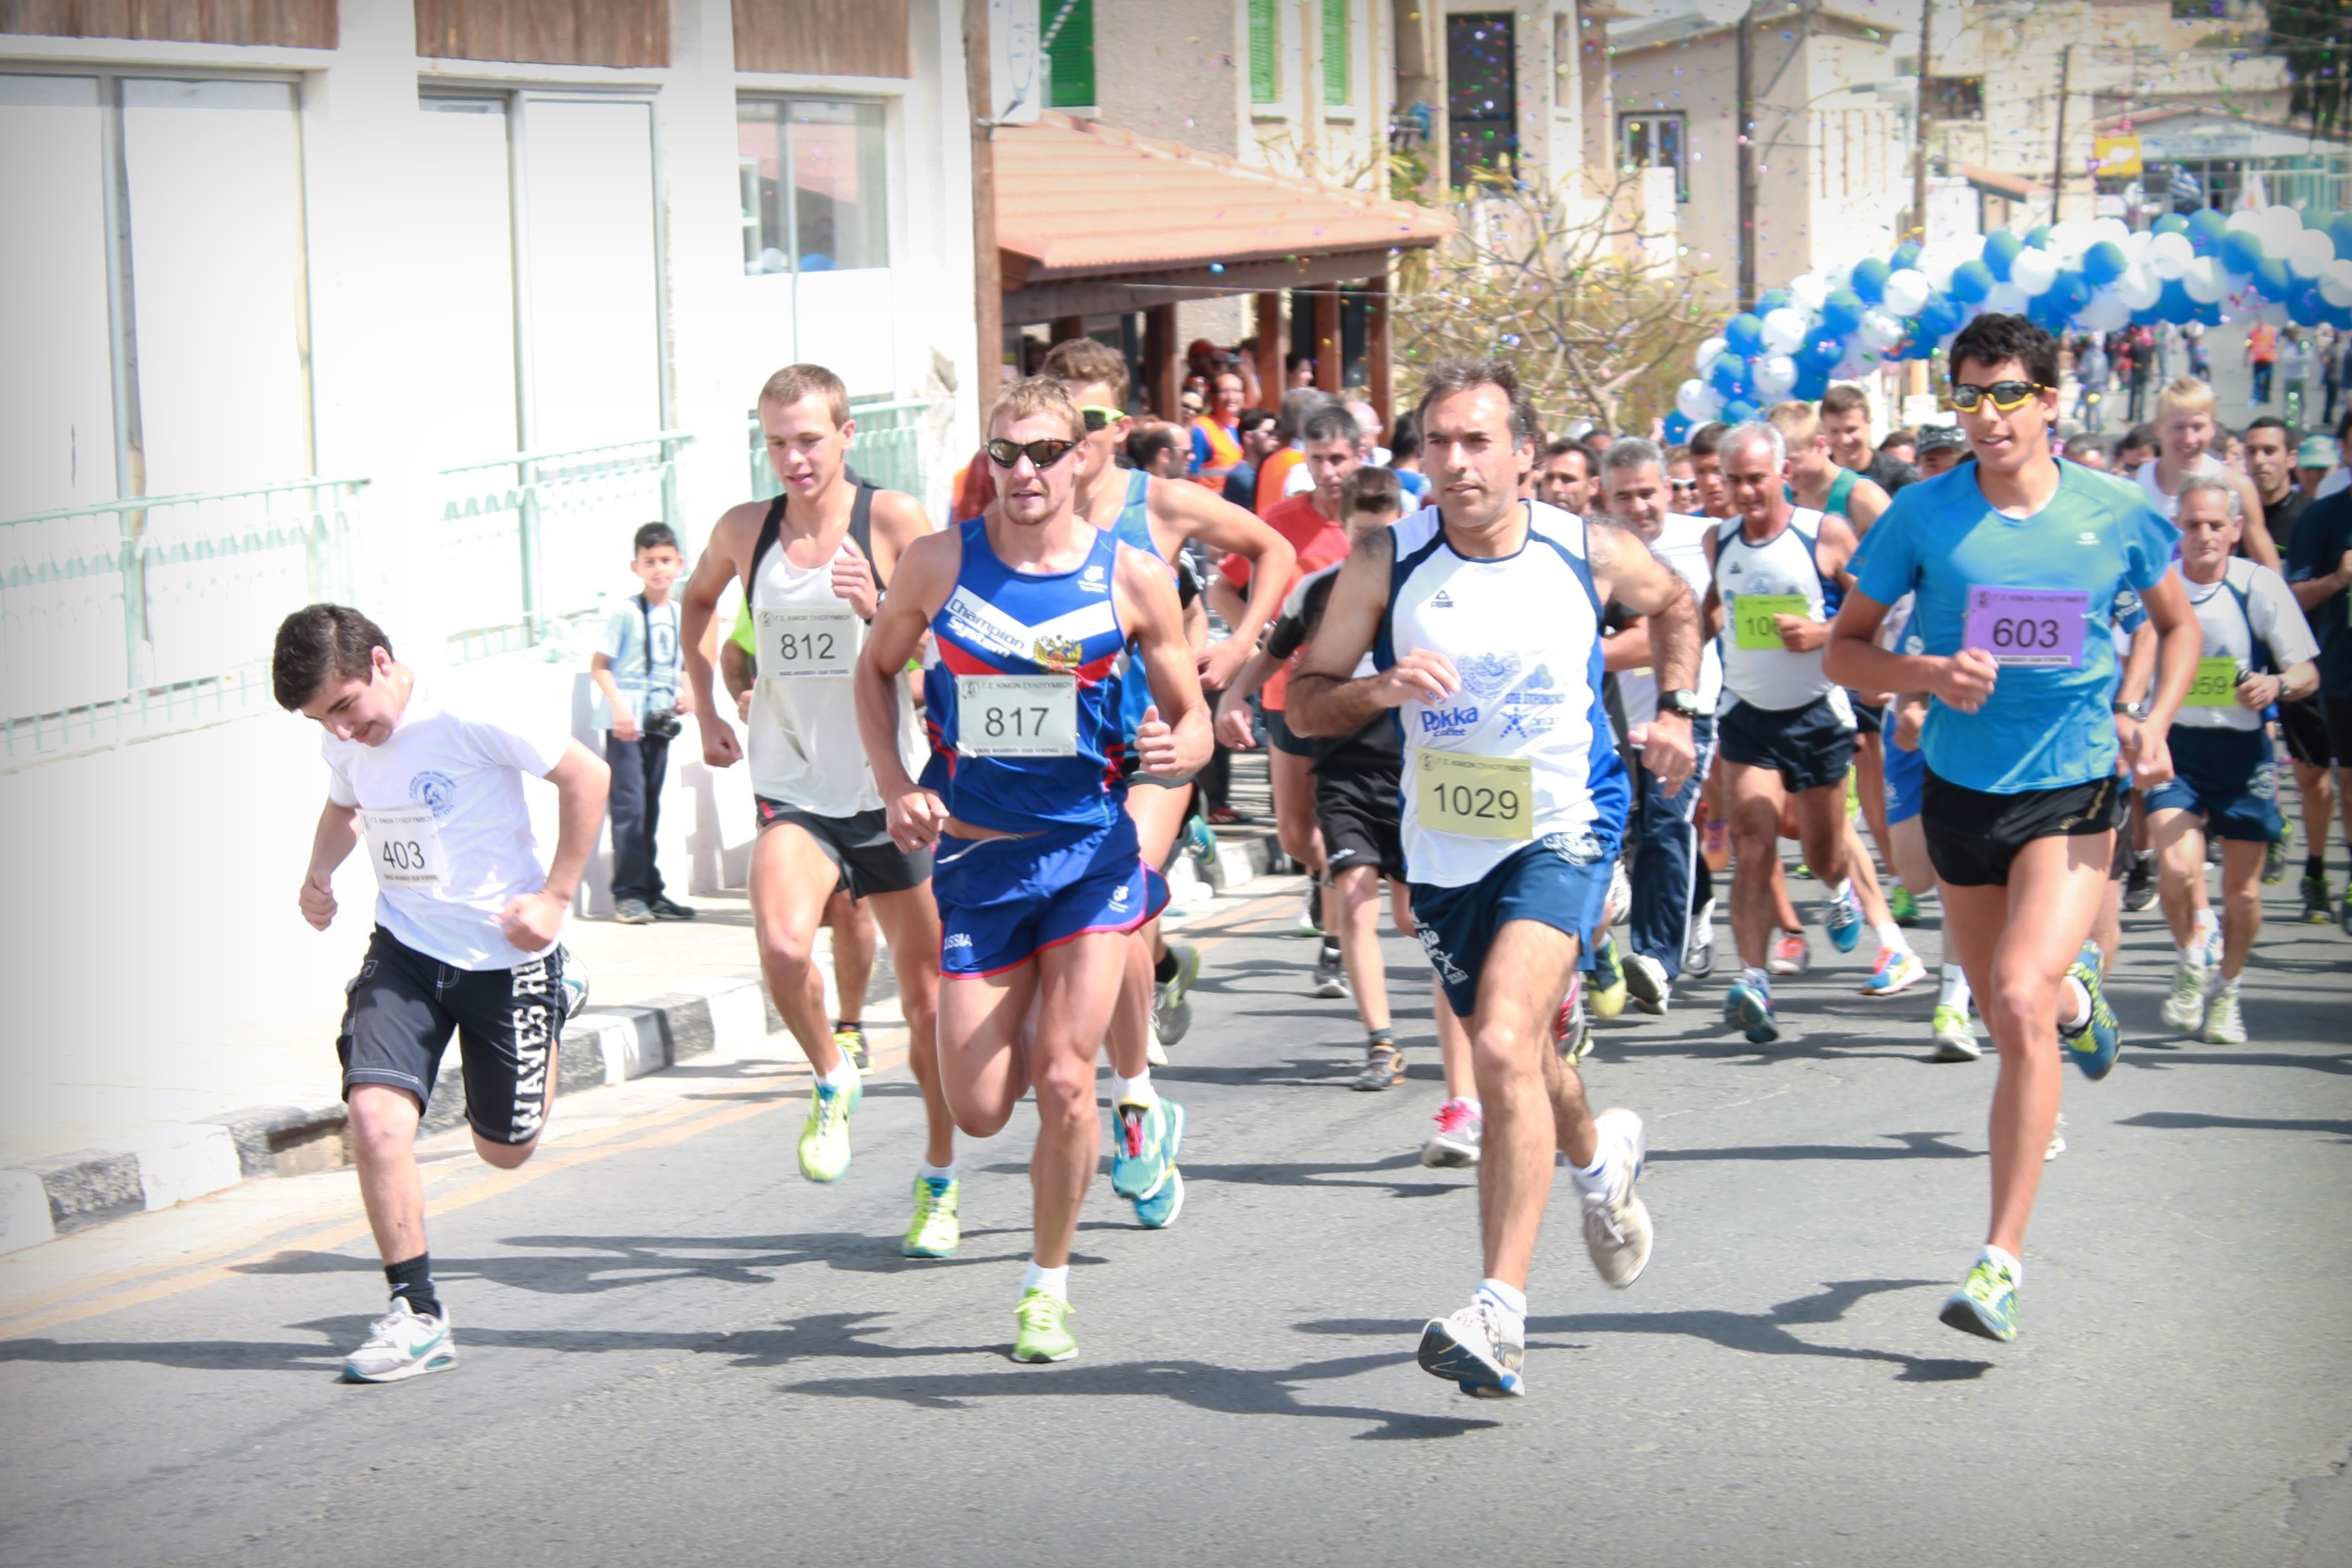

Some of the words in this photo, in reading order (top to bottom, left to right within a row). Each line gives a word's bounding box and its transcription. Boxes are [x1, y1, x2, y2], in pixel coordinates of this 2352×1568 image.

[947, 615, 1011, 658] System
[950, 598, 1024, 650] Champion
[1993, 618, 2059, 648] 603
[781, 633, 836, 660] 812
[985, 707, 1050, 736] 817
[1420, 706, 1479, 733] Pokka
[1433, 782, 1519, 820] 1029
[383, 840, 425, 869] 403
[509, 1004, 548, 1143] WAVES
